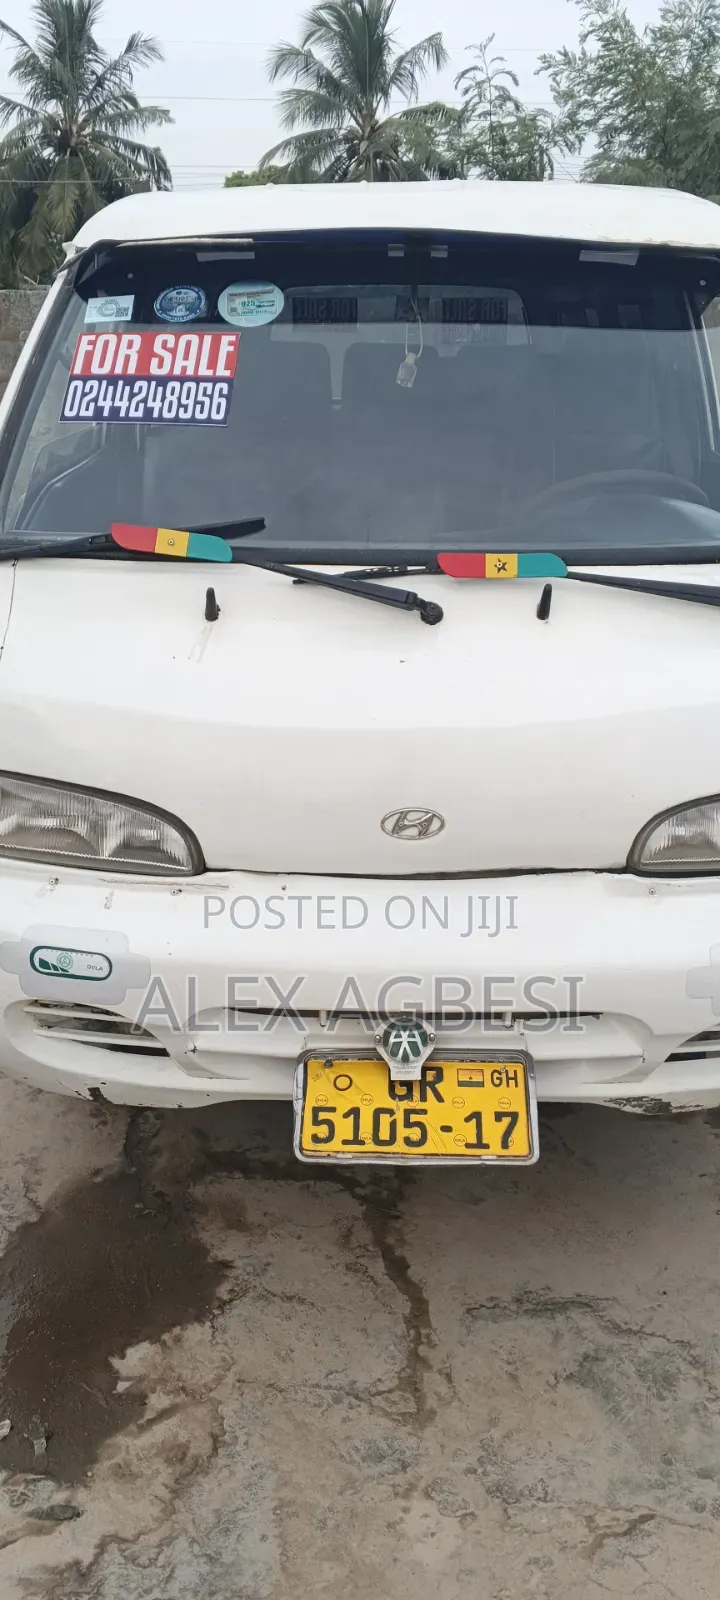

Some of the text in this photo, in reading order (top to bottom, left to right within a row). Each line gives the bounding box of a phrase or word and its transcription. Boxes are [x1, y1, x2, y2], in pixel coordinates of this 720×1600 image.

[73, 333, 239, 377] FOR SALE
[63, 379, 229, 420] 0244248956
[388, 1065, 519, 1103] GR GH
[311, 1106, 519, 1150] 5105-17
